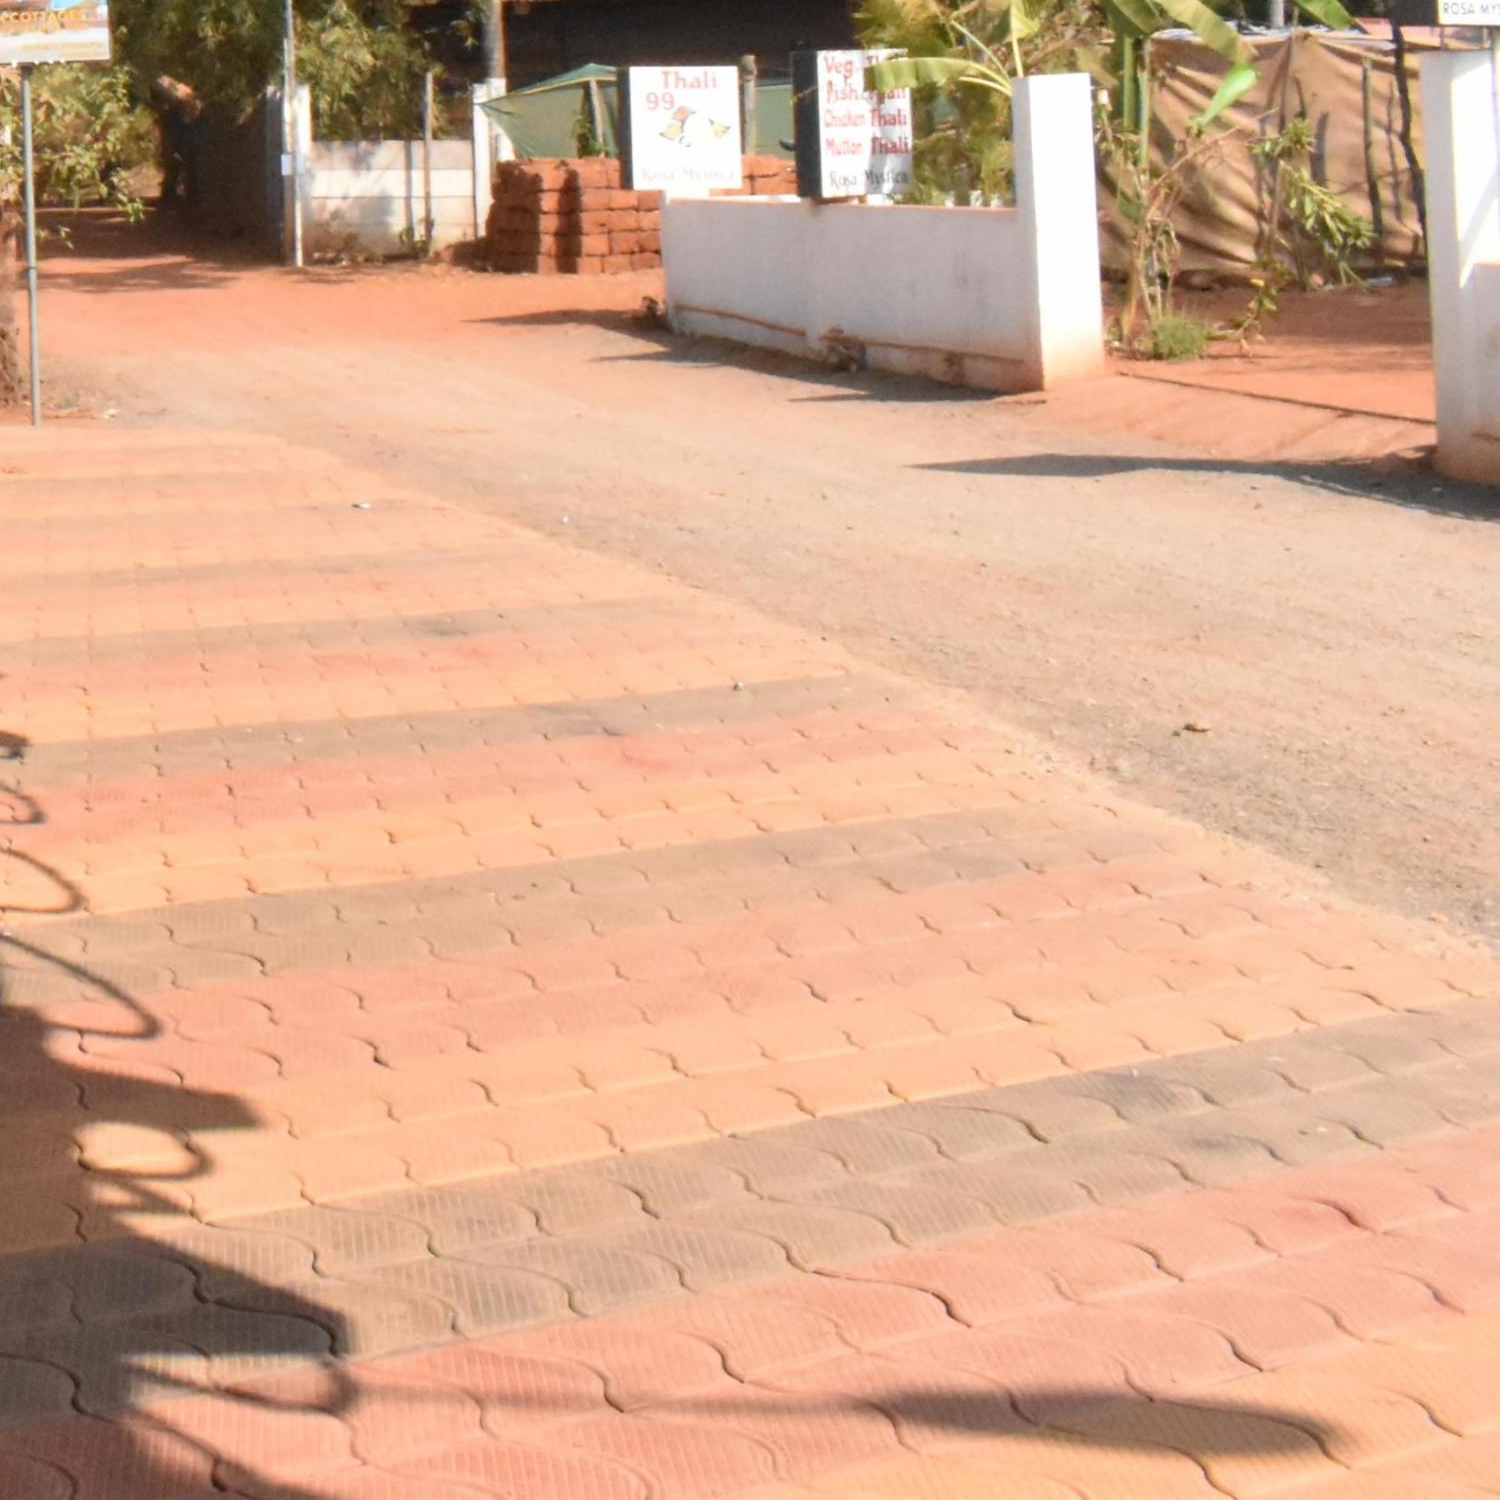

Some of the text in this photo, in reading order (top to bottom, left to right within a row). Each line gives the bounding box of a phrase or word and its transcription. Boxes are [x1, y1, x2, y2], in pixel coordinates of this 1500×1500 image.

[9, 9, 87, 24] COTTAGES
[1442, 2, 1476, 16] ROSA
[823, 55, 854, 78] Veg
[661, 70, 718, 90] Thali
[645, 91, 676, 111] 99
[823, 108, 907, 128] Chicken Thali
[824, 137, 910, 157] Mutton Thali
[829, 171, 858, 190] Rosa
